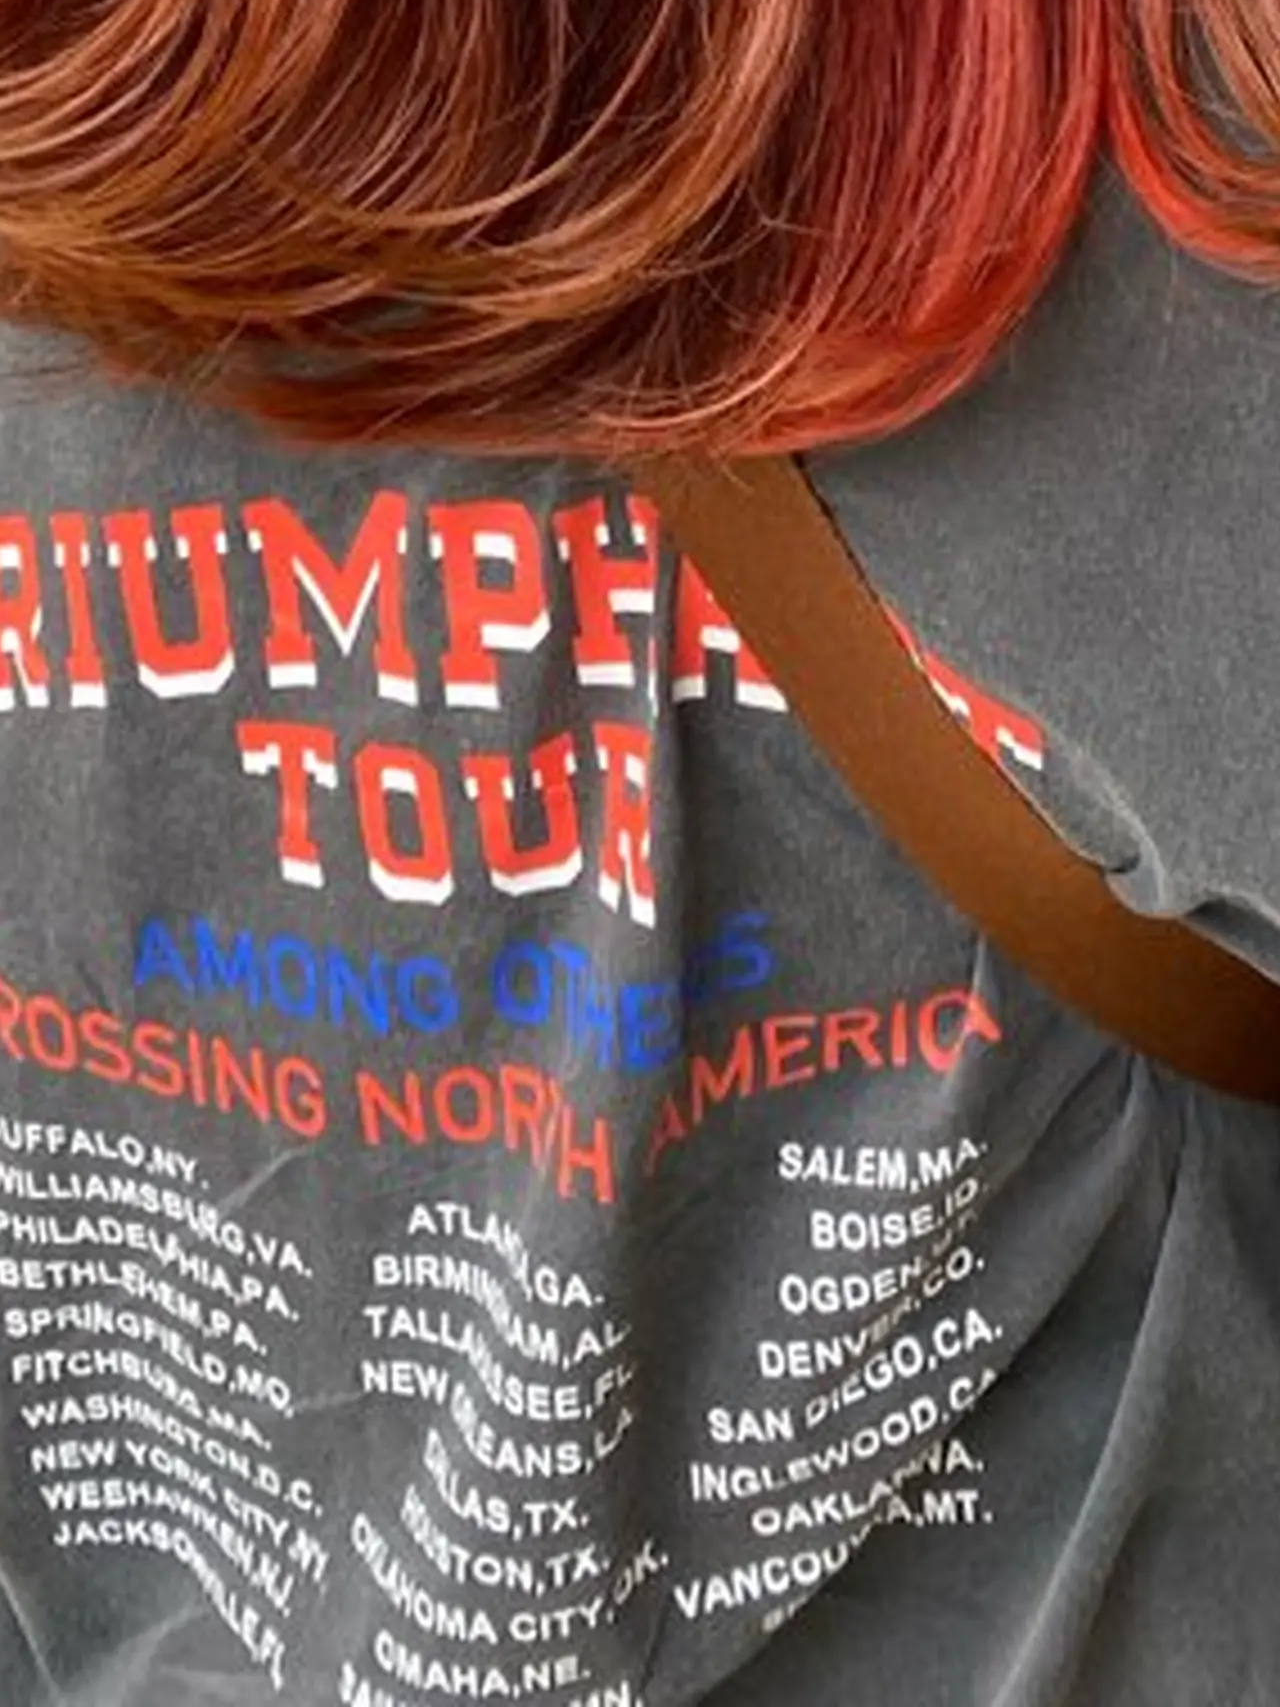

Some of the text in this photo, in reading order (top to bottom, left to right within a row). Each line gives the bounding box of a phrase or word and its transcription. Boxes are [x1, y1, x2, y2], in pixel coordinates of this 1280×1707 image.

[236, 718, 656, 929] TOUR
[132, 910, 776, 1071] AMONG OTHES
[361, 1359, 449, 1404] NEW
[707, 1407, 795, 1444] SAN
[31, 1440, 117, 1473] NEW
